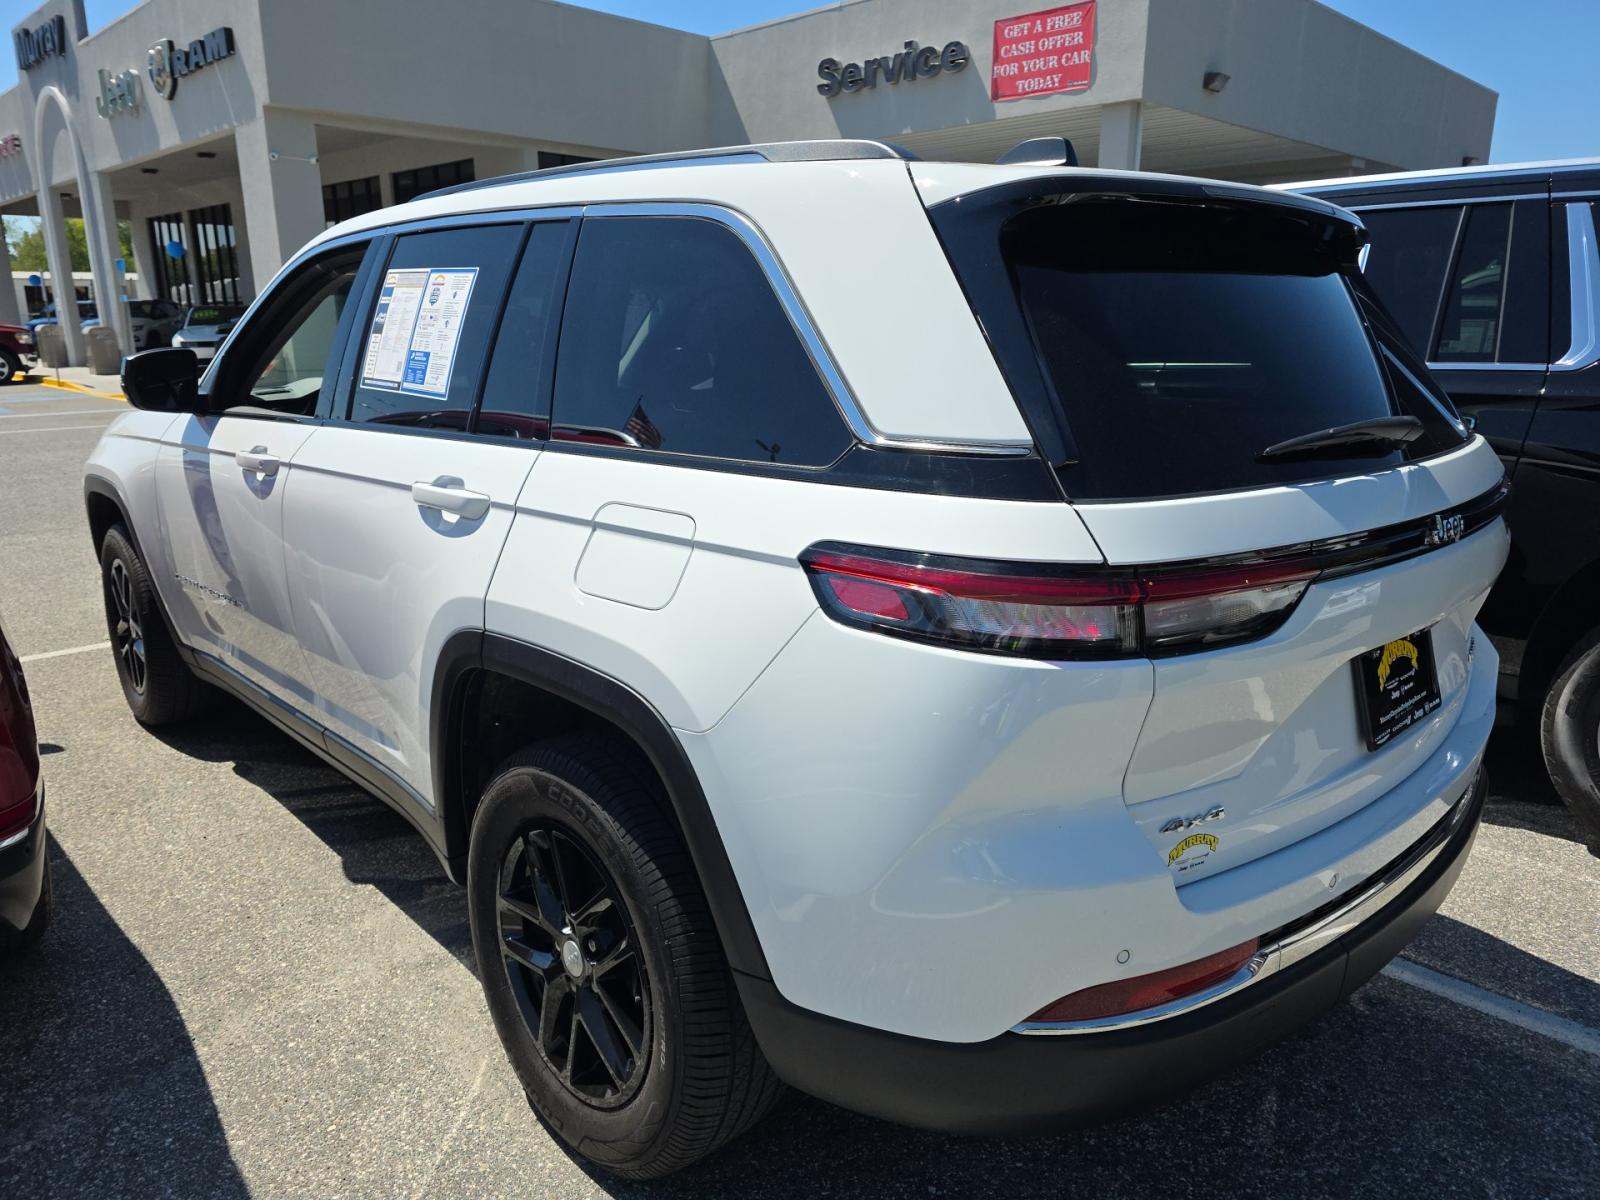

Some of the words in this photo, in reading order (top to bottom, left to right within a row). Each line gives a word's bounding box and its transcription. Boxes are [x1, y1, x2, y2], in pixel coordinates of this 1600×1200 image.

[1004, 22, 1031, 39] GET
[1033, 20, 1042, 33] A
[1046, 12, 1082, 31] FREE
[172, 27, 235, 79] RAM
[1000, 41, 1035, 58] CASH
[1039, 32, 1084, 51] OFFER
[817, 40, 971, 98] Service
[993, 63, 1019, 78] FOR
[1022, 56, 1058, 73] YOUR
[1061, 50, 1091, 67] CAR
[1016, 74, 1062, 92] TODAY
